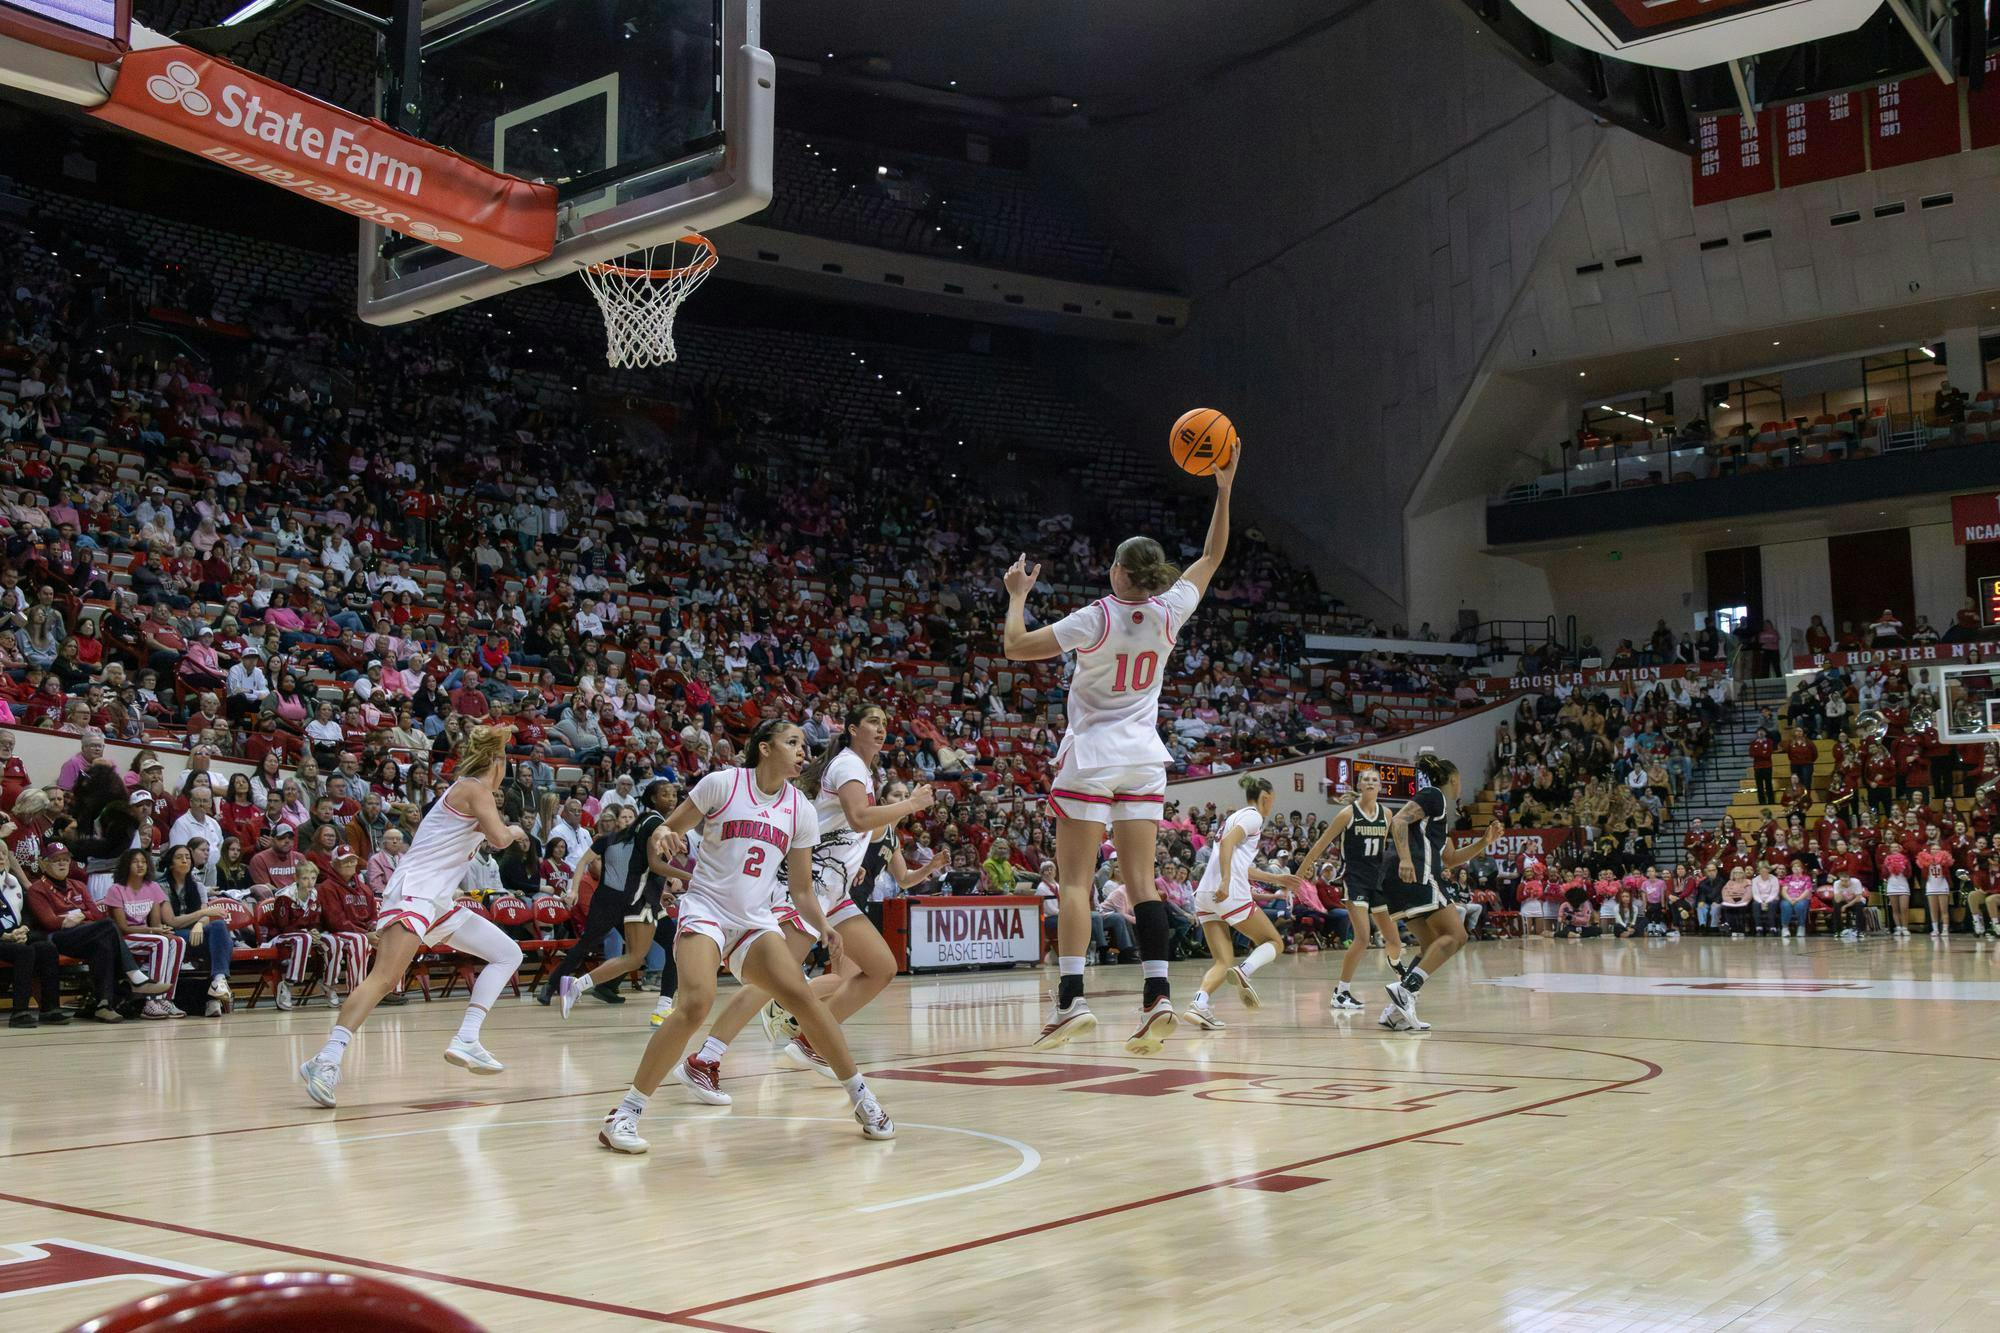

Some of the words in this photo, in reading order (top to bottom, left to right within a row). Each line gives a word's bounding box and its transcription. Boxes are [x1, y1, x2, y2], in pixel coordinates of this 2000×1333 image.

[1880, 122, 1901, 137] 1987
[1702, 162, 1720, 176] 1957
[1112, 651, 1158, 692] 10
[1596, 667, 1661, 682] NATION
[721, 820, 789, 856] INDIAN
[1355, 825, 1386, 836] PURDUE
[1364, 838, 1380, 856] 11
[743, 846, 765, 877] 2
[460, 900, 484, 910] DIANA
[496, 900, 526, 911] INDIANA
[537, 900, 565, 911] INDIANA
[926, 908, 1024, 943] INDIANA
[938, 942, 1014, 962] BASKETBALL
